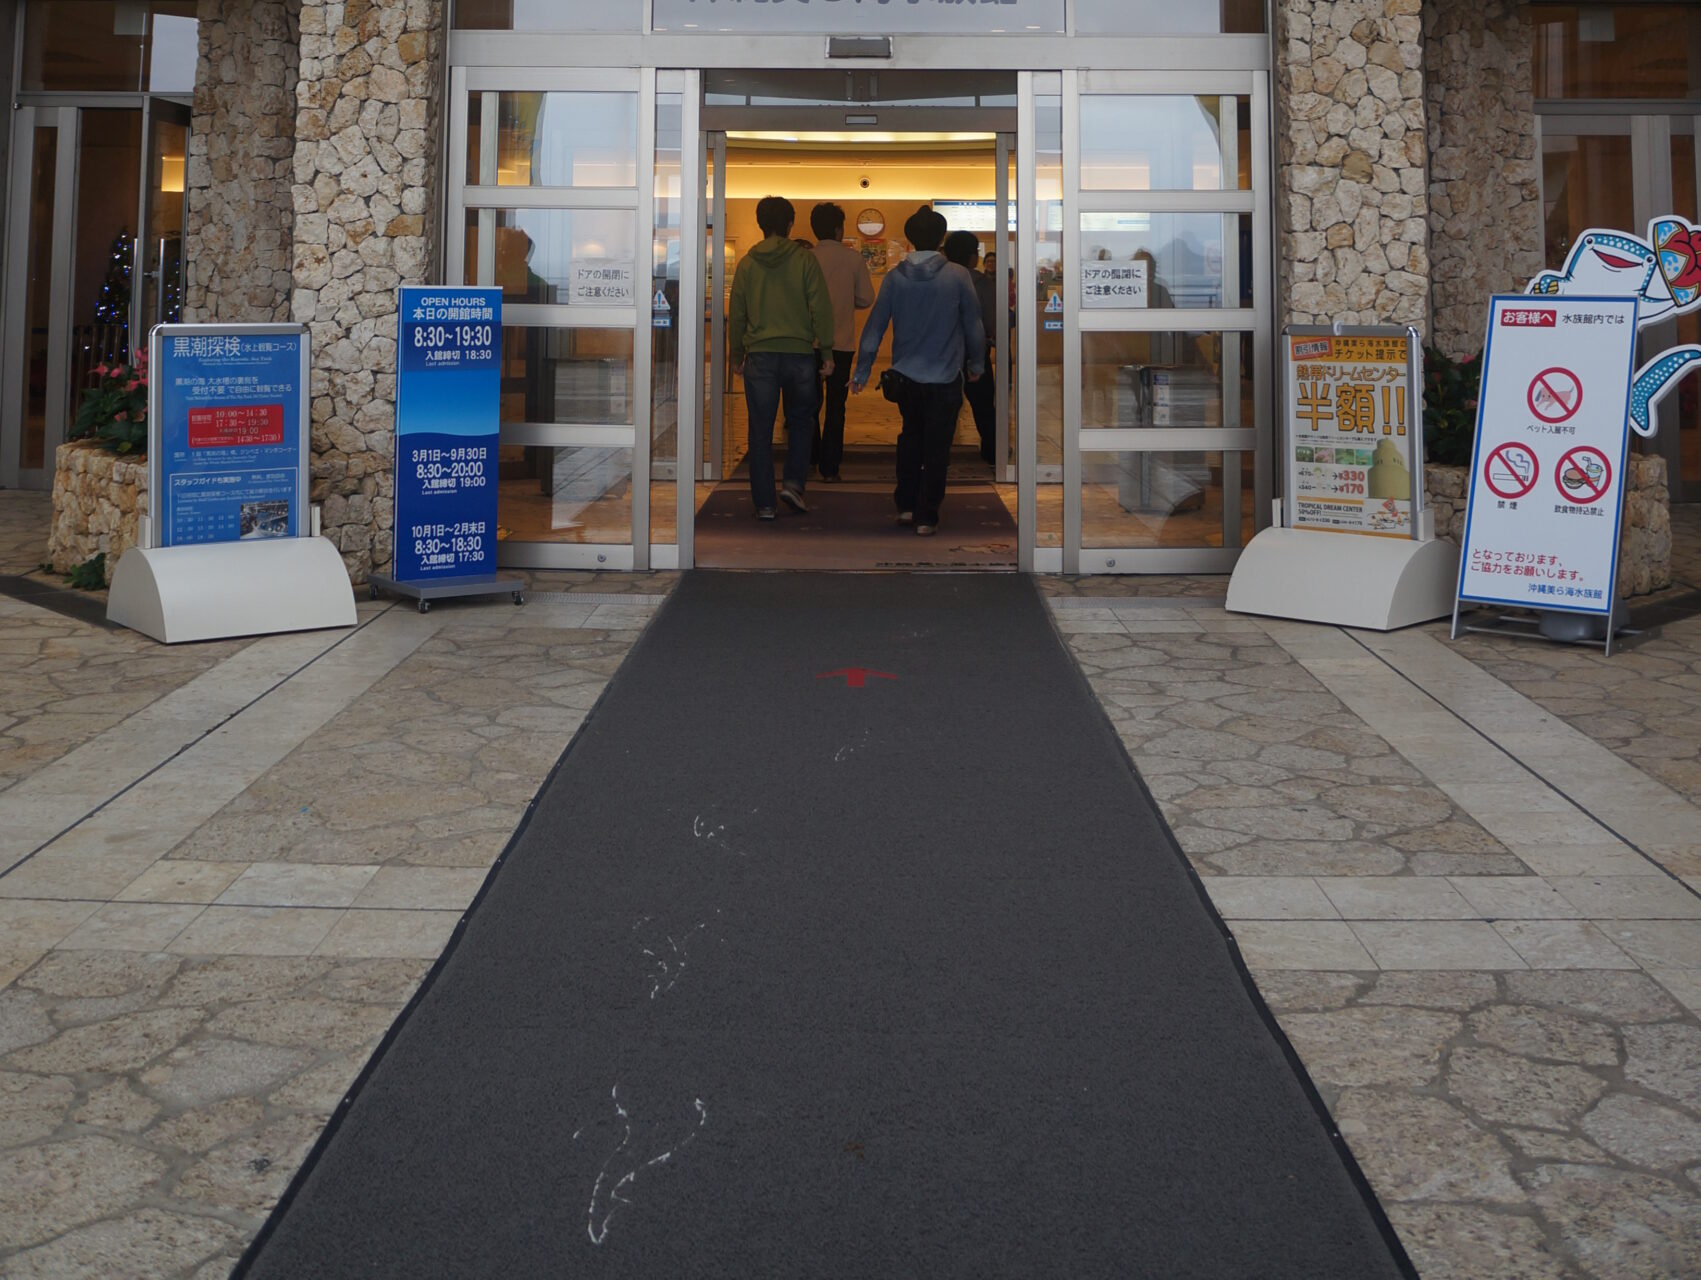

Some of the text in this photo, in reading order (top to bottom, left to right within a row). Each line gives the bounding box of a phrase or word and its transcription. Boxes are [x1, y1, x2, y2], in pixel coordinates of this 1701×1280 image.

[1085, 285, 1142, 296] ご注意ください
[421, 297, 486, 307] OPEN HOURS
[413, 307, 493, 320] 本日の開館時間
[1503, 311, 1625, 325] お客様へ 水族館内では
[173, 336, 241, 358] 黒潮探検
[465, 350, 492, 360] 18:30
[1296, 363, 1406, 383] 熱帯ドリームセンター
[460, 477, 486, 488] 19:00
[1554, 504, 1605, 517] 飲食物持込禁止
[459, 551, 485, 562] 17:30
[1471, 561, 1584, 582] ご協力をお願いします。
[1528, 583, 1603, 600] 沖縄美ら海水族館
